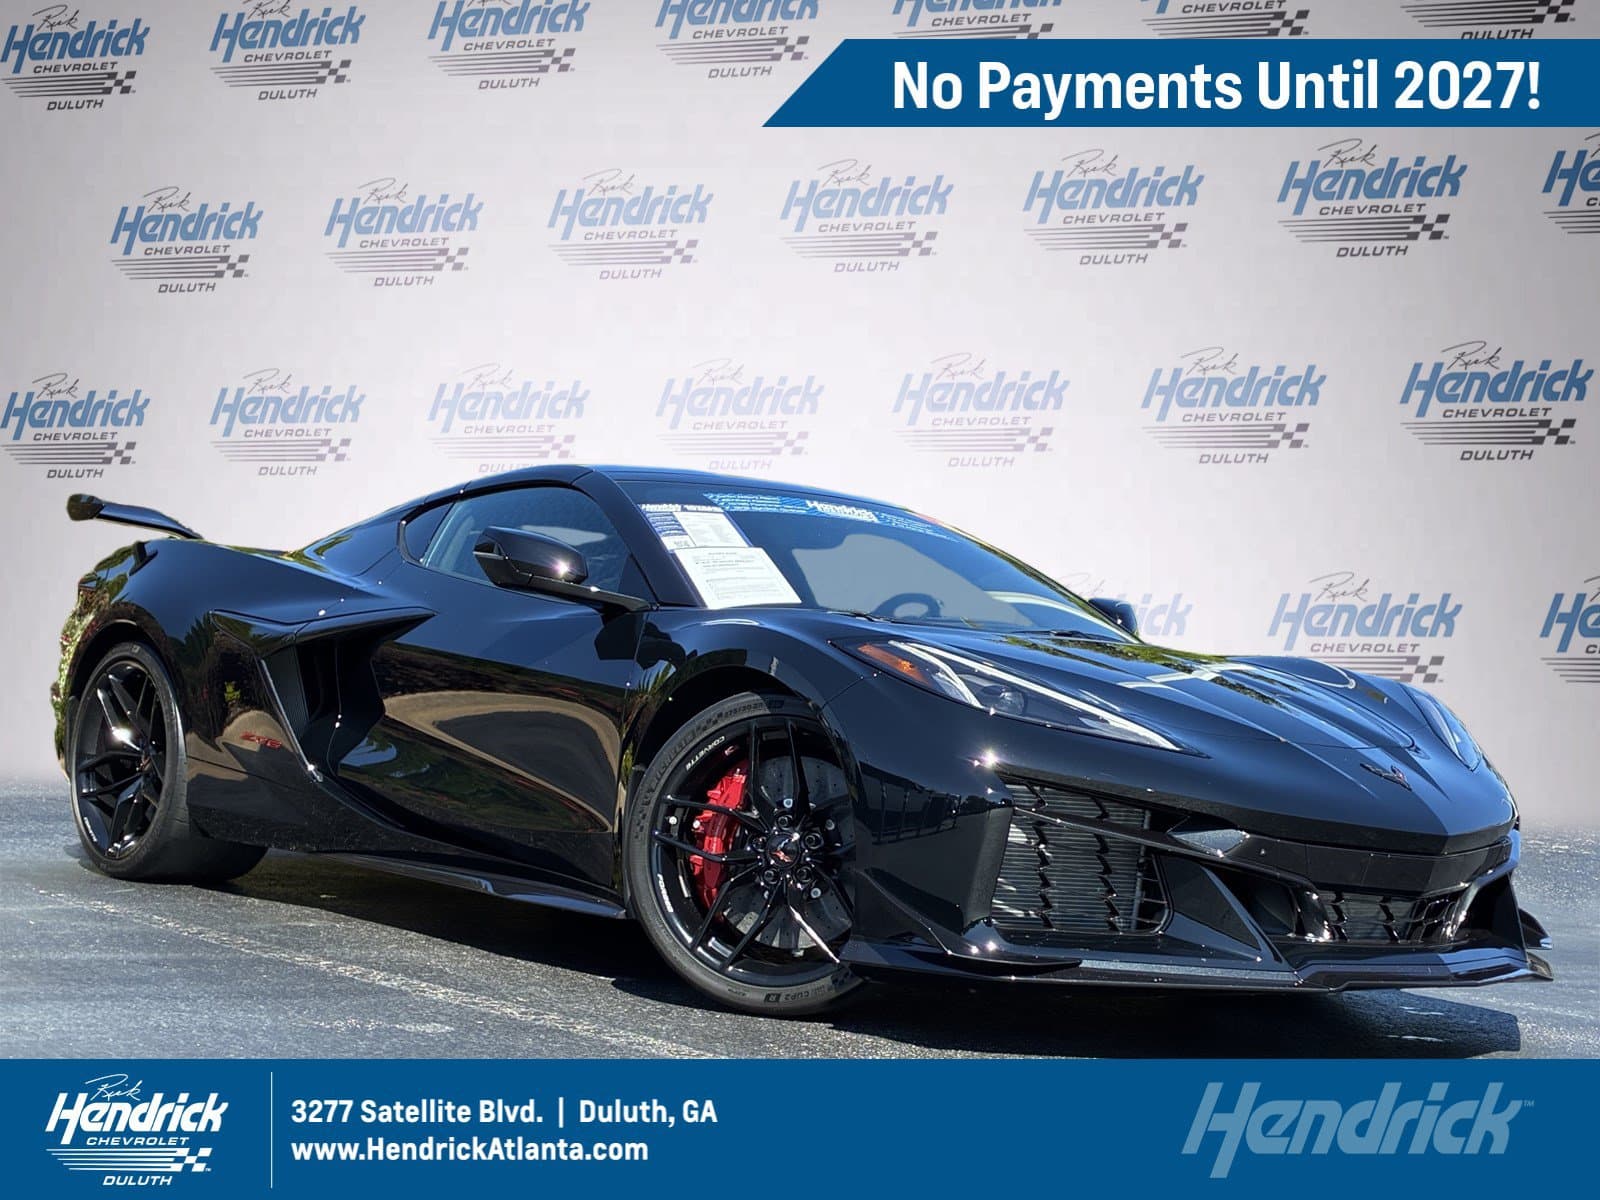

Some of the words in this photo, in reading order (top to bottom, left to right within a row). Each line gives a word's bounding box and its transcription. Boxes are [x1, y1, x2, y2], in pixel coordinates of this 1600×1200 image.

[428, 0, 590, 52] Hendrick
[931, 12, 1033, 28] CHEVROLET
[209, 6, 366, 63] Hendrick
[692, 25, 789, 40] CHEVROLET
[0, 18, 149, 75] Hendrick
[463, 37, 556, 52] CHEVROLET
[243, 49, 333, 64] CHEVROLET
[32, 61, 118, 75] CHEVROLET
[707, 65, 773, 79] DULUTH
[477, 77, 541, 91] DULUTH
[257, 87, 318, 101] DULUTH
[46, 98, 105, 111] DULUTH
[1277, 155, 1469, 206] Hendrick
[1024, 165, 1204, 224] Hendrick
[780, 175, 955, 232] Hendrick
[1319, 202, 1427, 216] CHEVROLET
[548, 184, 712, 240] Hendrick
[1062, 211, 1166, 225] CHEVROLET
[324, 193, 484, 248] Hendrick
[817, 220, 917, 233] CHEVROLET
[111, 202, 263, 256] Hendrick
[583, 228, 679, 241] CHEVROLET
[359, 236, 450, 249] CHEVROLET
[143, 244, 231, 257] CHEVROLET
[1335, 244, 1409, 258] DULUTH
[1079, 252, 1149, 266] DULUTH
[833, 260, 901, 273] DULUTH
[598, 267, 663, 281] DULUTH
[157, 281, 217, 294] DULUTH
[373, 275, 435, 288] DULUTH
[1142, 363, 1328, 421] Hendrick
[1400, 359, 1594, 417] Hendrick
[656, 376, 825, 430] Hendrick
[893, 369, 1070, 426] Hendrick
[209, 384, 366, 441] Hendrick
[427, 379, 590, 433] Hendrick
[1442, 407, 1553, 419] CHEVROLET
[0, 389, 149, 441] Hendrick
[930, 415, 1033, 428] CHEVROLET
[1182, 411, 1288, 423] CHEVROLET
[463, 423, 556, 435] CHEVROLET
[691, 419, 789, 432] CHEVROLET
[32, 431, 118, 442] CHEVROLET
[242, 427, 333, 439] CHEVROLET
[1198, 452, 1270, 465] DULUTH
[1459, 448, 1535, 461] DULUTH
[706, 457, 774, 471] DULUTH
[947, 455, 1016, 469] DULUTH
[46, 468, 105, 479] DULUTH
[257, 465, 318, 477] DULUTH
[1268, 590, 1463, 652] Hendrick
[1310, 642, 1421, 654] CHEVROLET
